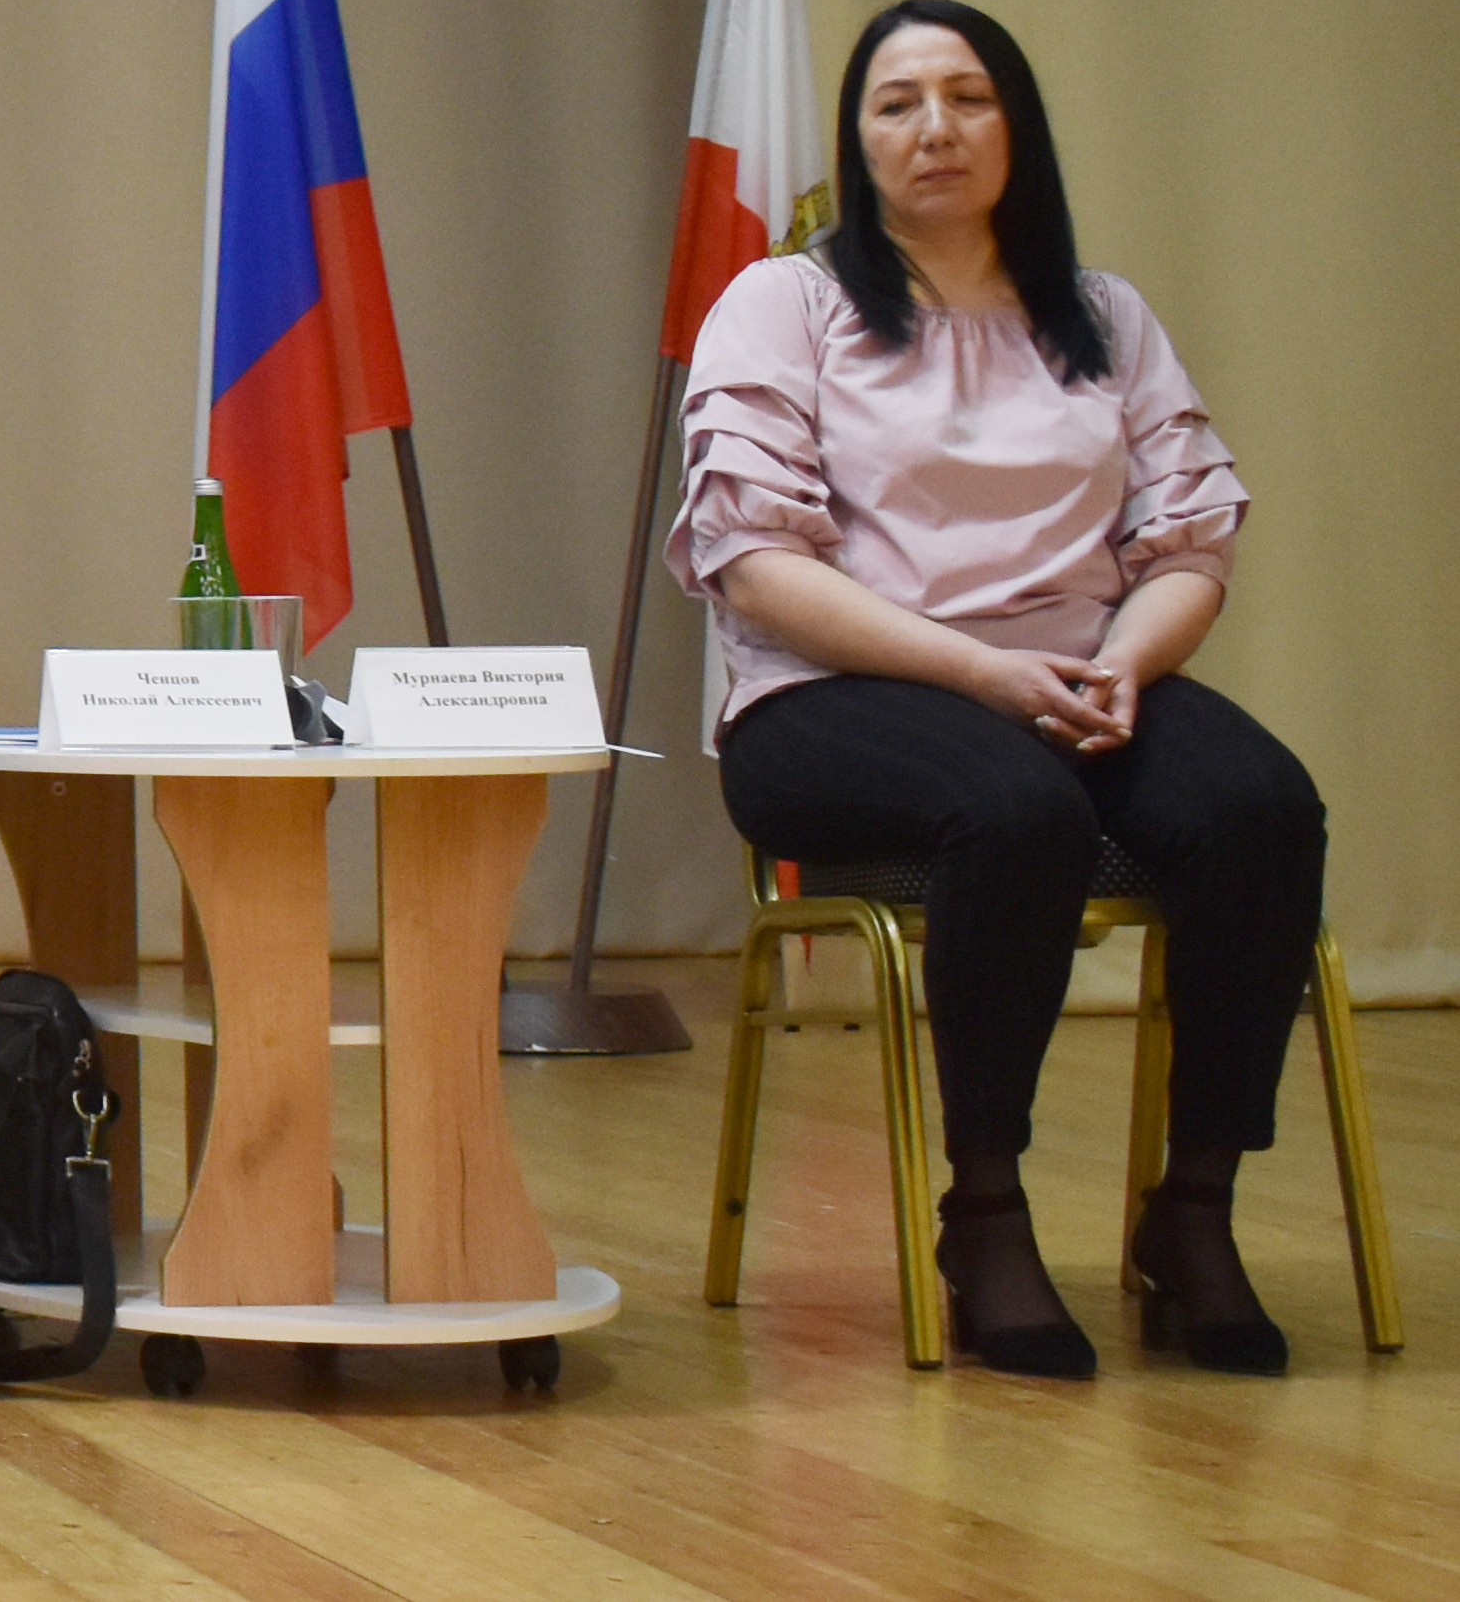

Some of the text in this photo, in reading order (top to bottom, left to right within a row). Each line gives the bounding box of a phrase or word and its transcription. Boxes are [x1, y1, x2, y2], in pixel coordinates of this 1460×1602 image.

[137, 672, 201, 686] Ченцов
[393, 670, 565, 688] Мурнаева Виктория
[82, 693, 262, 707] Николай Алексеевич
[419, 694, 548, 709] Александровна
